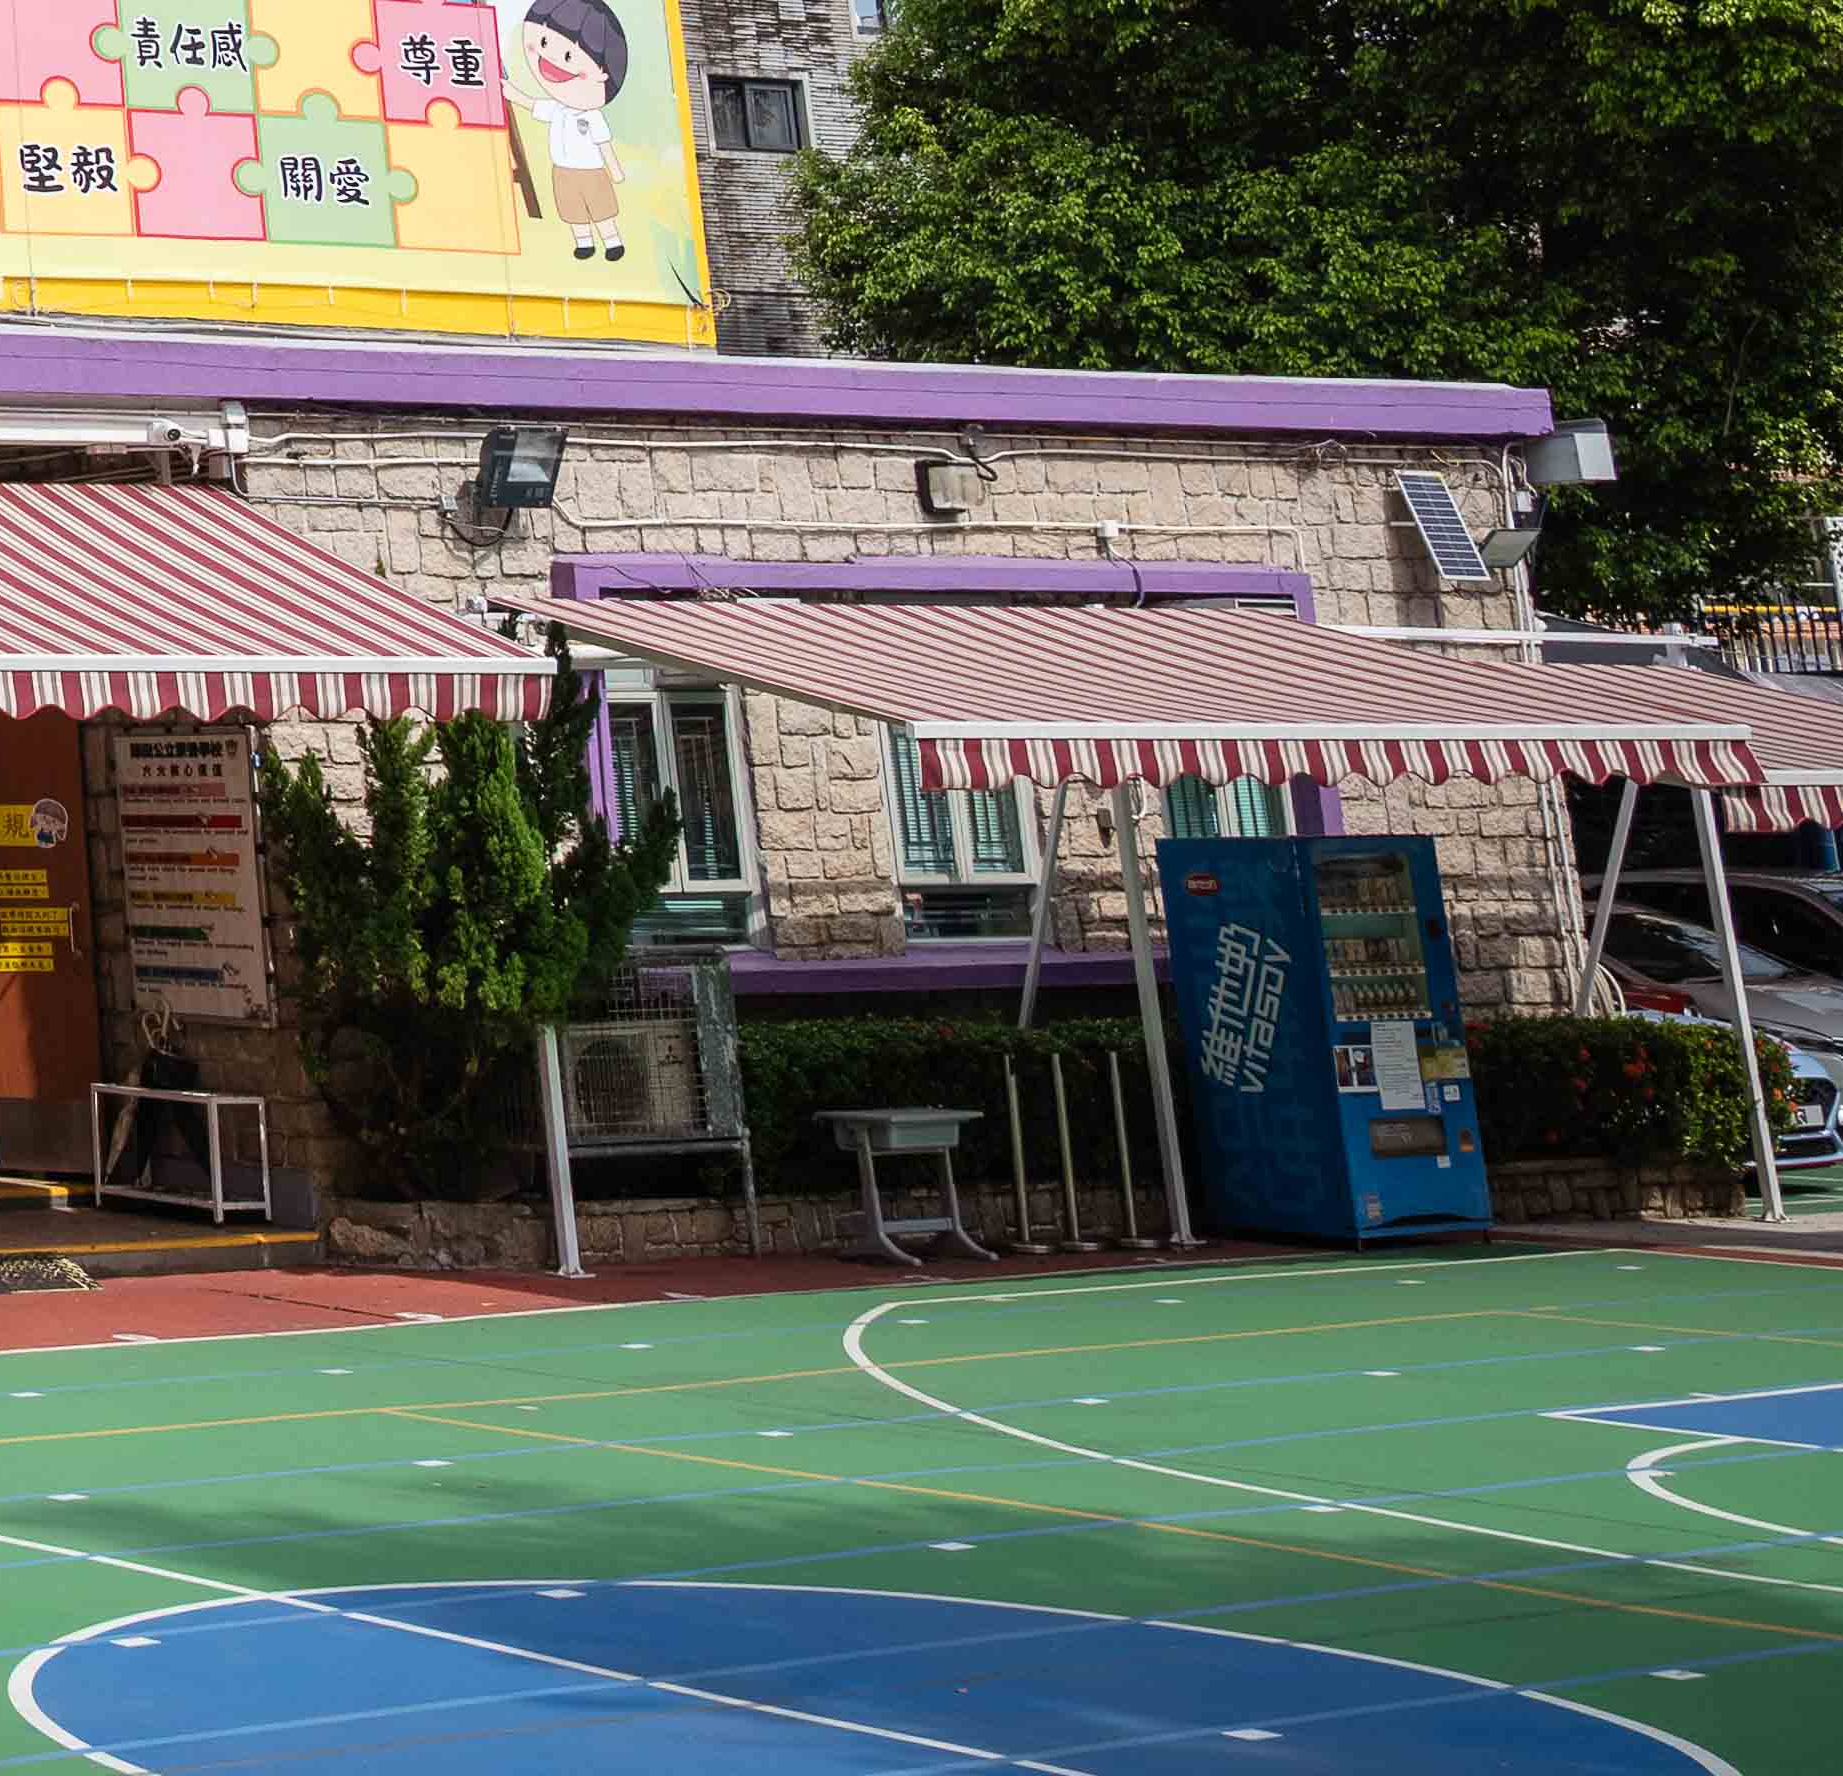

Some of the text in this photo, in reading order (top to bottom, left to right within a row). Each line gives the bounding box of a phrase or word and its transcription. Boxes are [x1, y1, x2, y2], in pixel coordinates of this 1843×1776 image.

[129, 16, 248, 73] 責任感
[399, 33, 487, 88] 尊重
[19, 143, 119, 195] 堅毅
[279, 154, 372, 207] 關愛
